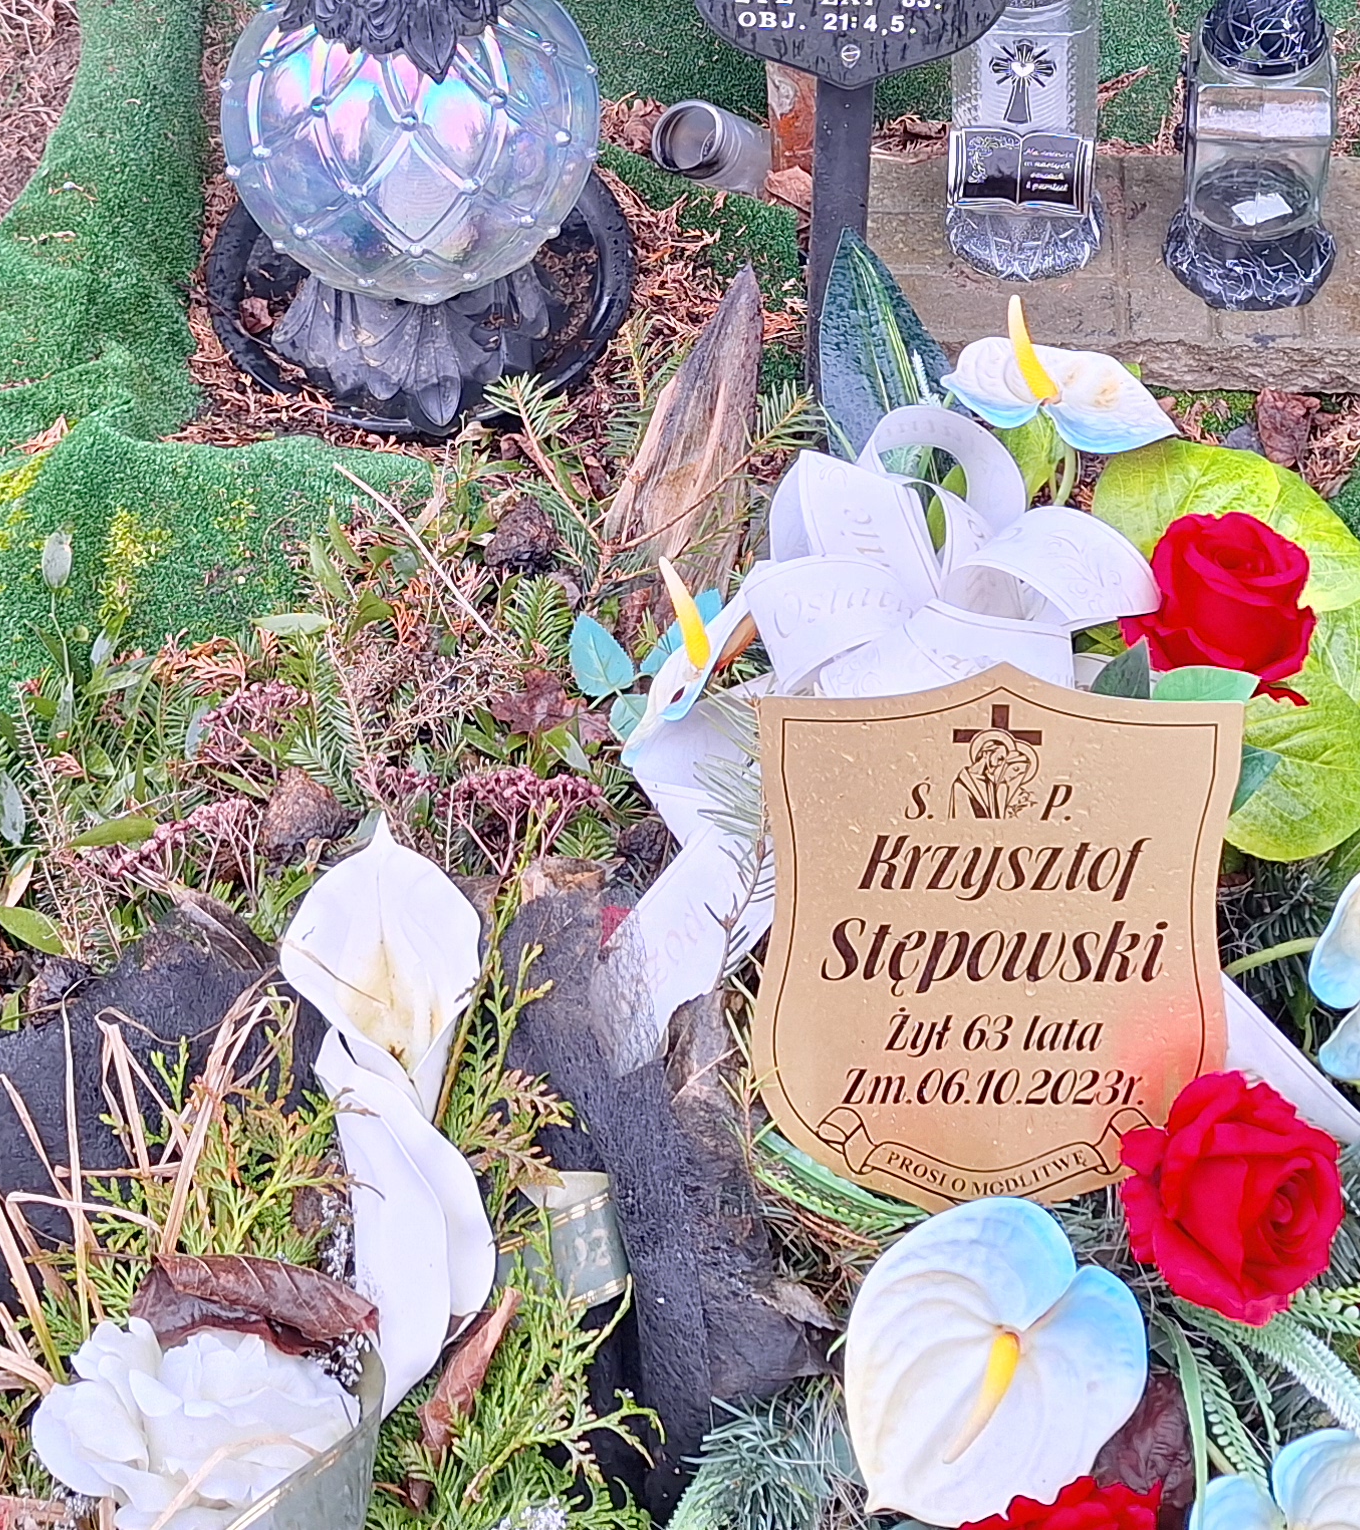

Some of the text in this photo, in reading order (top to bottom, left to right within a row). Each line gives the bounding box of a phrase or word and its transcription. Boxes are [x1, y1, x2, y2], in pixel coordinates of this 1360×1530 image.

[738, 12, 806, 30] OBJ.
[905, 777, 1072, 821] Ś. P.
[857, 834, 1152, 902] Krzysztof
[821, 918, 1168, 997] Stępowski
[885, 1007, 1104, 1058] Żył 63 lata
[886, 1149, 1088, 1197] PROSI O MODLITWĘ
